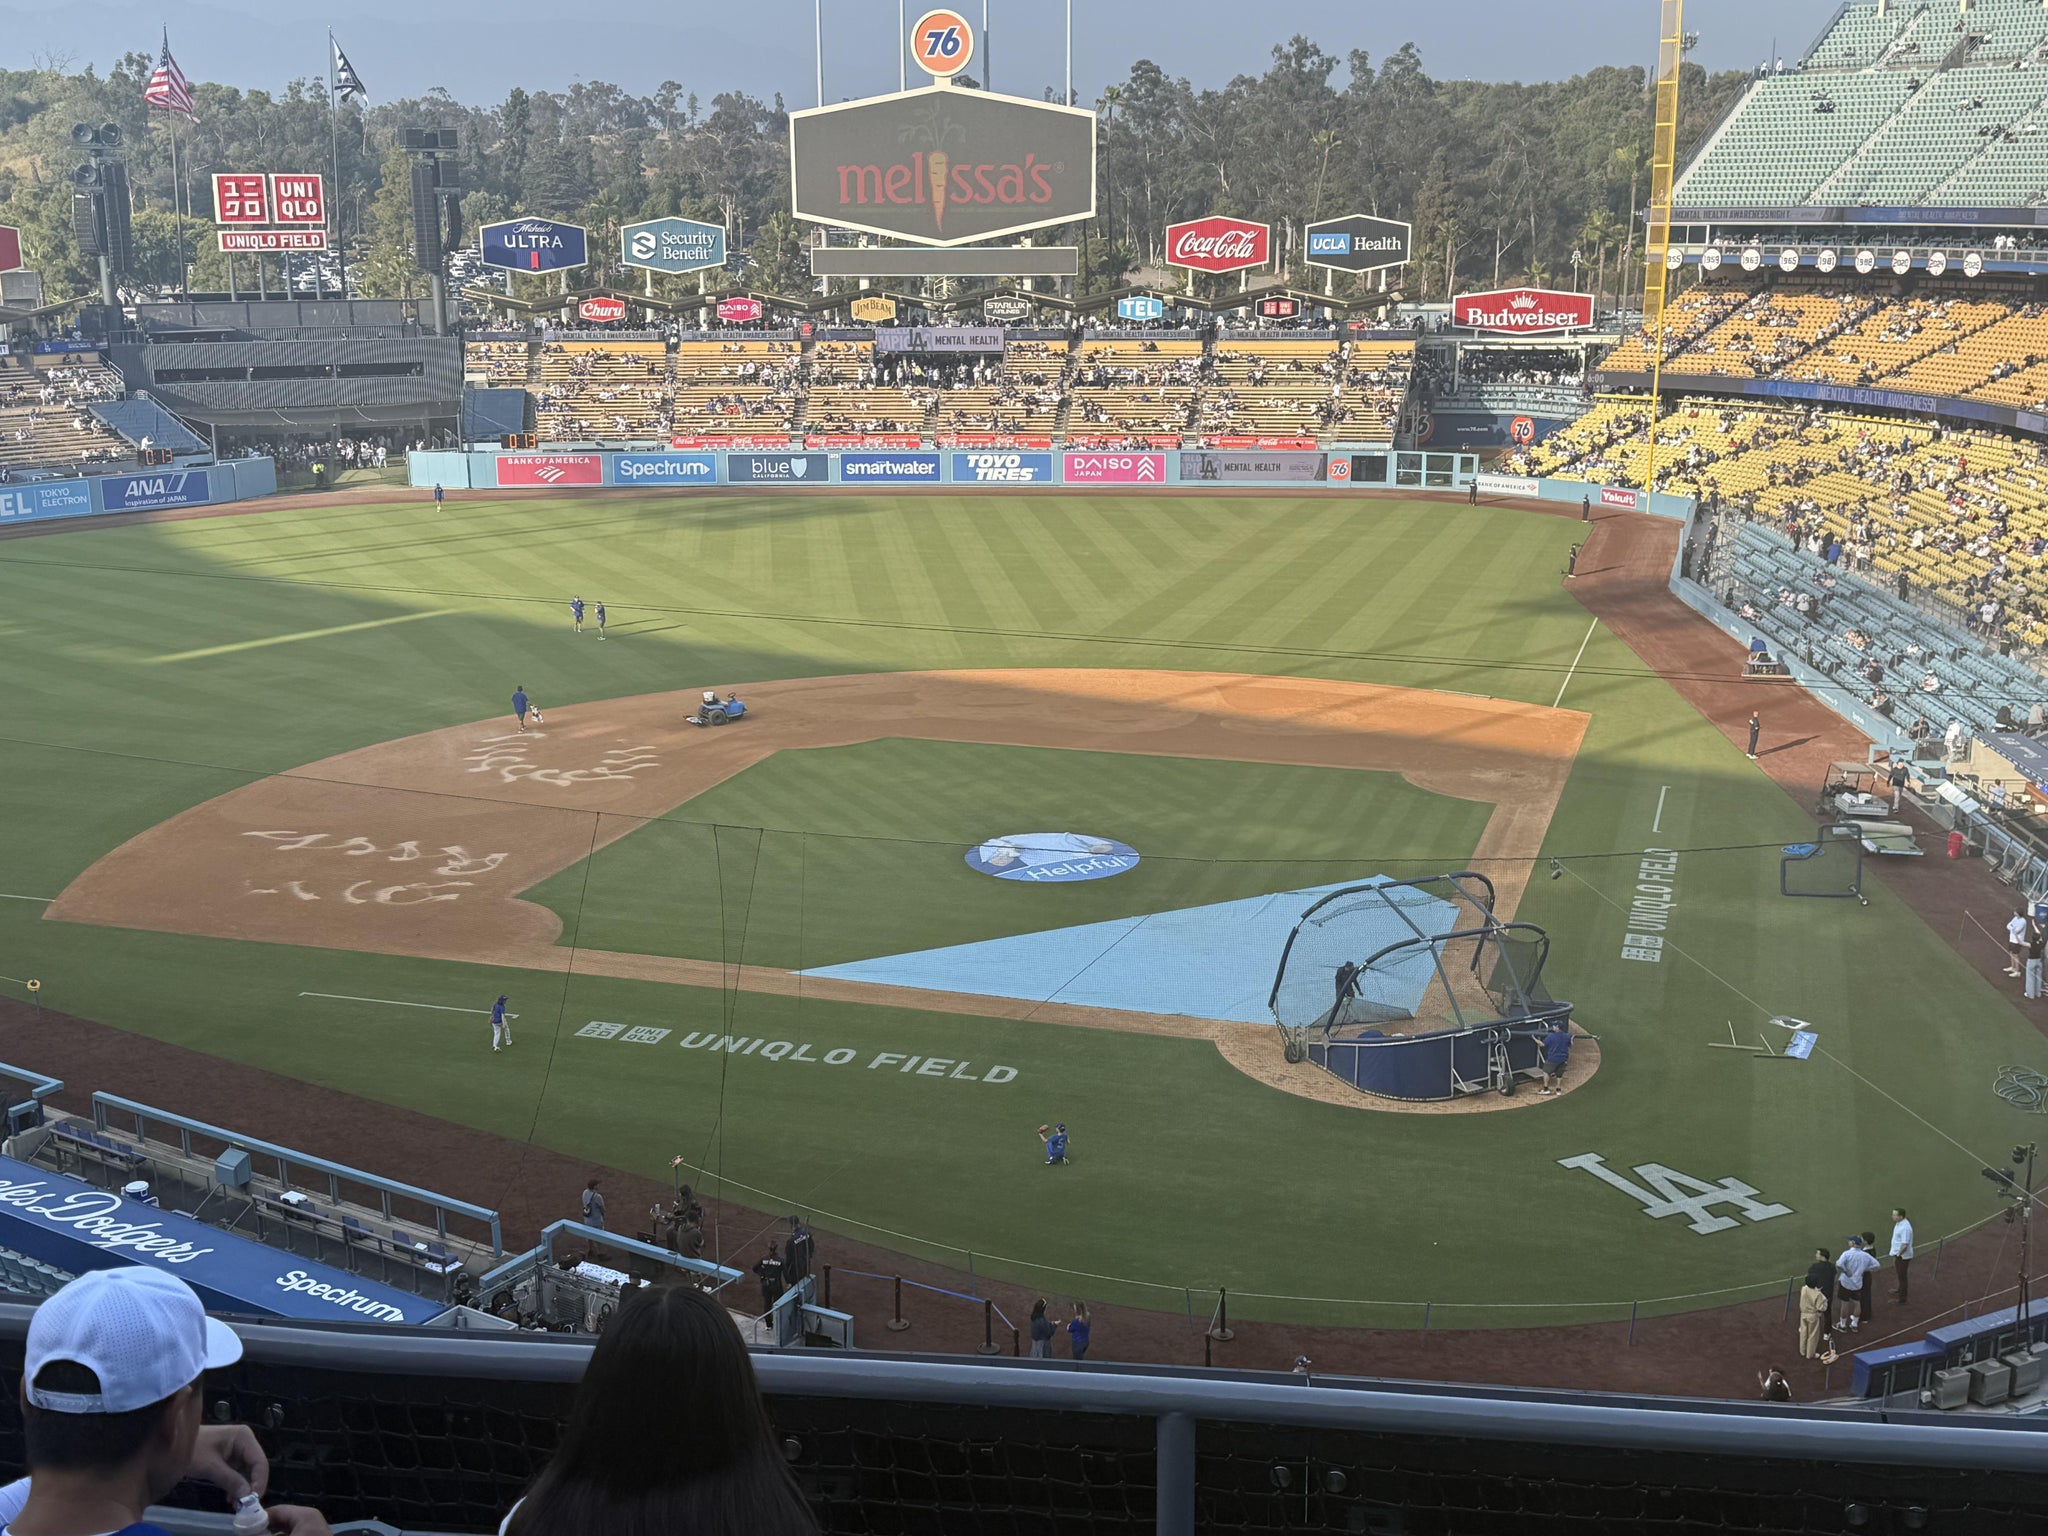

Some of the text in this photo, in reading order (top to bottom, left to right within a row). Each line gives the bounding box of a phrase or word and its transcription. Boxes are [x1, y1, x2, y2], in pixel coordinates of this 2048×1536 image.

[924, 25, 961, 58] 76
[837, 151, 1052, 206] melissa's
[224, 182, 259, 197] ユニ
[280, 182, 313, 197] UNI
[281, 200, 318, 218] QLO
[1675, 209, 1700, 219] MENTAL
[1703, 209, 1727, 219] HEALTH
[1729, 209, 1769, 219] AWARENESS
[513, 223, 552, 234] Michelob
[226, 235, 320, 249] UNIQLO FIELD
[504, 235, 563, 249] ULTRA
[661, 231, 716, 249] Security
[1175, 230, 1260, 259] Coca-Cola
[1312, 236, 1402, 251] UCLA Health
[663, 247, 710, 260] Benefit
[1743, 255, 1759, 265] 1963
[1781, 256, 1797, 265] 1965
[581, 302, 623, 317] Churu
[854, 299, 892, 316] JIM BEAM
[986, 302, 1026, 310] STARLUX
[1123, 301, 1157, 316] TEL
[935, 335, 998, 345] MENTAL HEALTH
[1587, 373, 1604, 383] 6:00
[1854, 389, 1883, 405] HEALTH
[1515, 422, 1531, 437] 76
[549, 457, 590, 465] AMERICA
[752, 458, 790, 474] blue
[846, 460, 934, 475] smartwater
[967, 455, 1021, 467] TOYO
[1074, 458, 1133, 469] DAISO
[1224, 463, 1252, 472] MENTAL
[1254, 463, 1281, 472] HEALTH
[620, 459, 705, 479] Spectrum
[975, 468, 1034, 480] TIRES
[1331, 463, 1347, 475] 76
[40, 488, 70, 498] TOKYO
[125, 478, 165, 498] ANA
[42, 496, 88, 507] ELECTRON
[125, 498, 157, 507] Inspiration
[166, 495, 187, 503] JAPAN
[1602, 490, 1636, 507] Yakult
[1026, 856, 1126, 880] Helpful
[1638, 848, 1679, 882] FIELD
[1627, 884, 1677, 930] UNIQLO
[627, 1034, 657, 1042] QLO
[635, 1027, 662, 1035] UNI
[679, 1032, 1019, 1083] UNIQLO FIELD
[1555, 1152, 1797, 1235] LA
[25, 1191, 214, 1263] Dodgers
[276, 1270, 402, 1322] Spectrum
